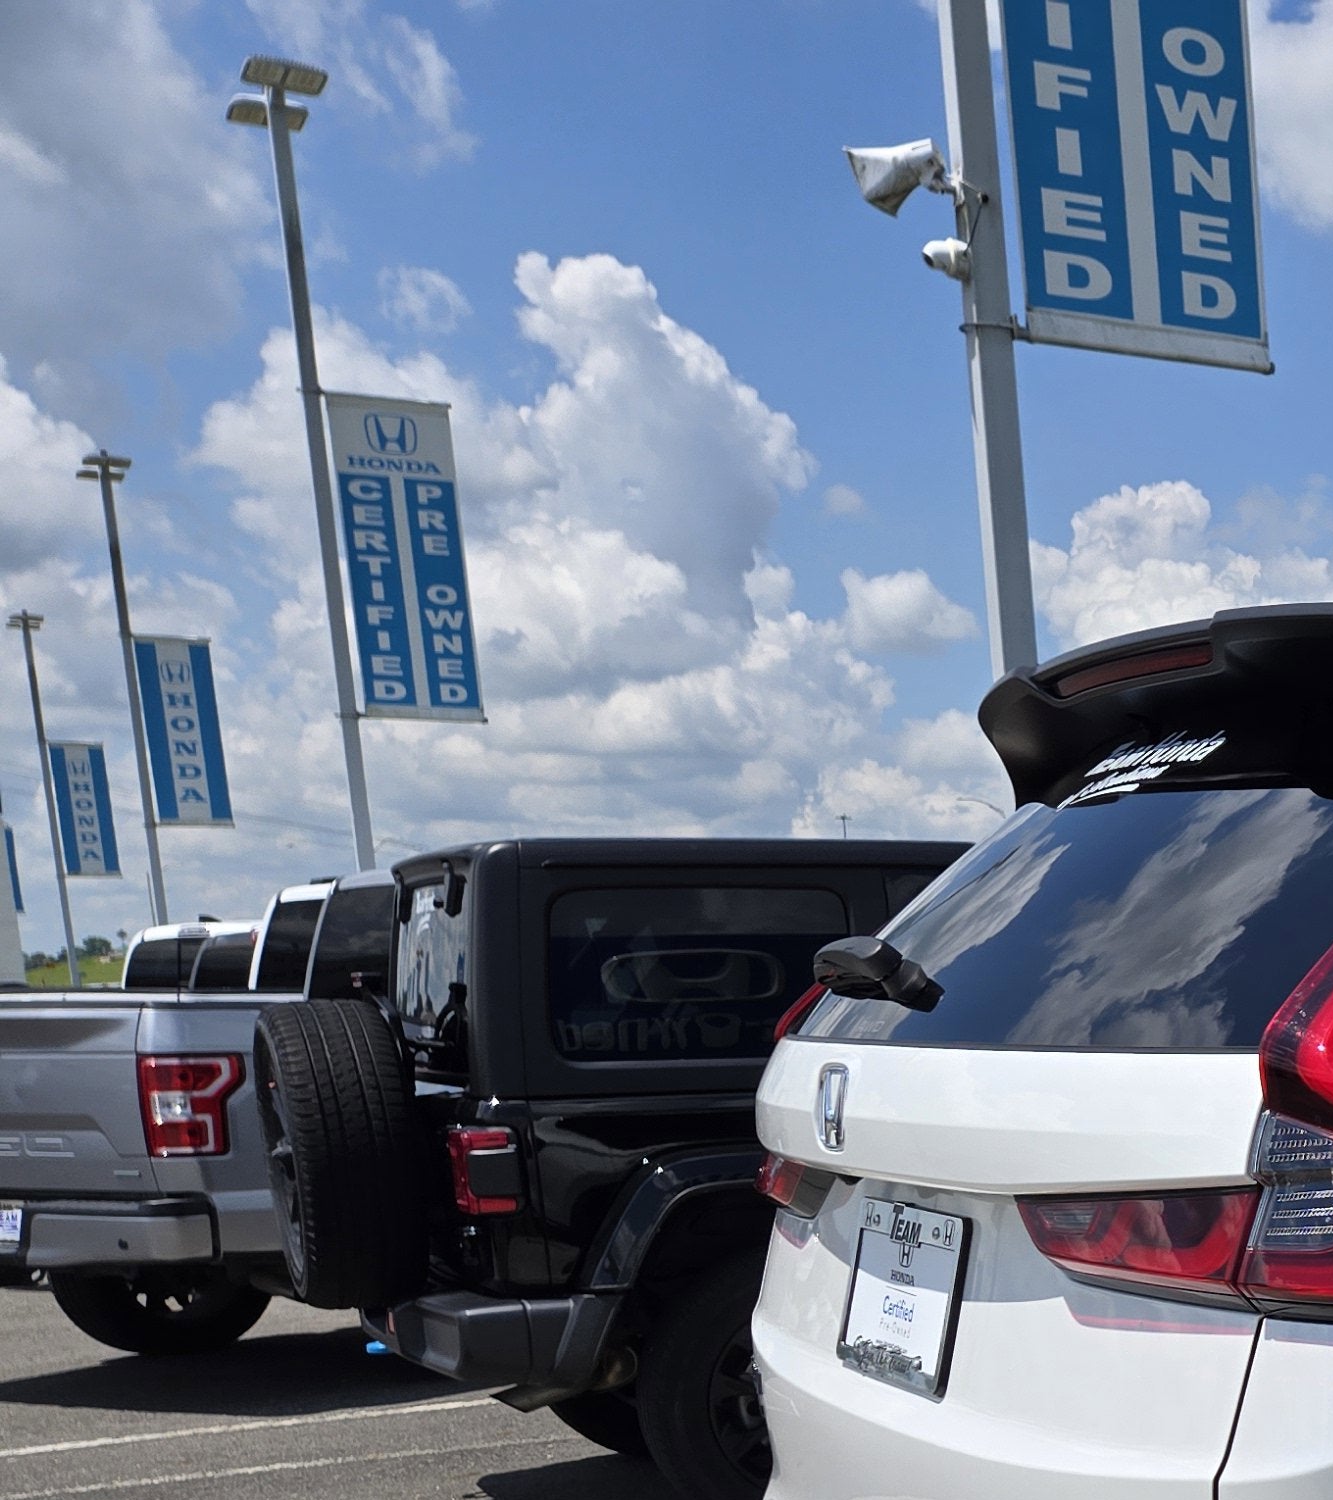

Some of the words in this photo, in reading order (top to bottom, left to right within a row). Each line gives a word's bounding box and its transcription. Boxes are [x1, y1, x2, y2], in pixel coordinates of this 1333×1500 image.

[1155, 27, 1237, 320] OWNED
[347, 456, 441, 474] HONDA
[416, 484, 451, 556] PRE
[347, 478, 407, 702] CERTIFIED
[425, 584, 468, 704] OWNED
[165, 692, 208, 804] HONDA
[72, 781, 100, 861] HONDA
[890, 1203, 922, 1245] TEAM
[882, 1295, 915, 1323] Certified
[890, 1269, 915, 1286] HONDA
